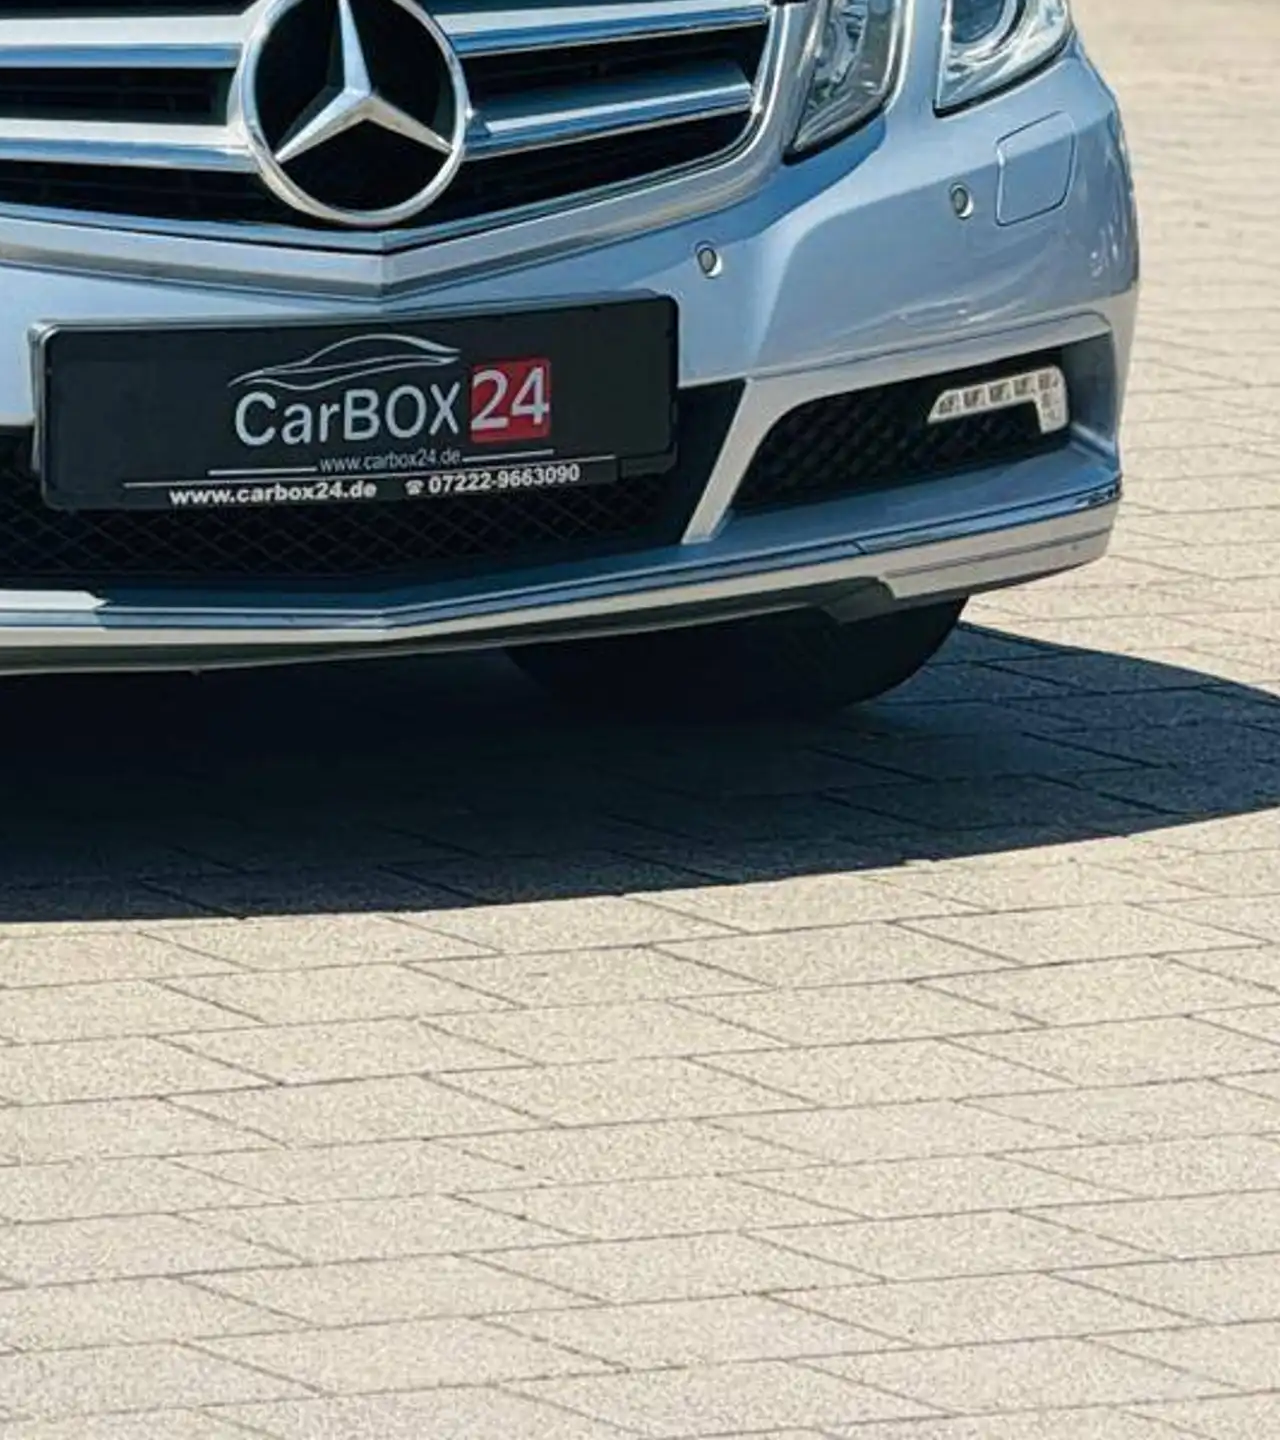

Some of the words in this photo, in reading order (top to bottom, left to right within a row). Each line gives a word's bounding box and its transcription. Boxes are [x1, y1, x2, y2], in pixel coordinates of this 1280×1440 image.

[235, 382, 460, 446] CarBOX
[471, 367, 550, 430] 24
[320, 448, 461, 472] www.carbox24.de
[169, 480, 377, 505] www.carbox24.de
[429, 464, 581, 494] 07222-9663090
